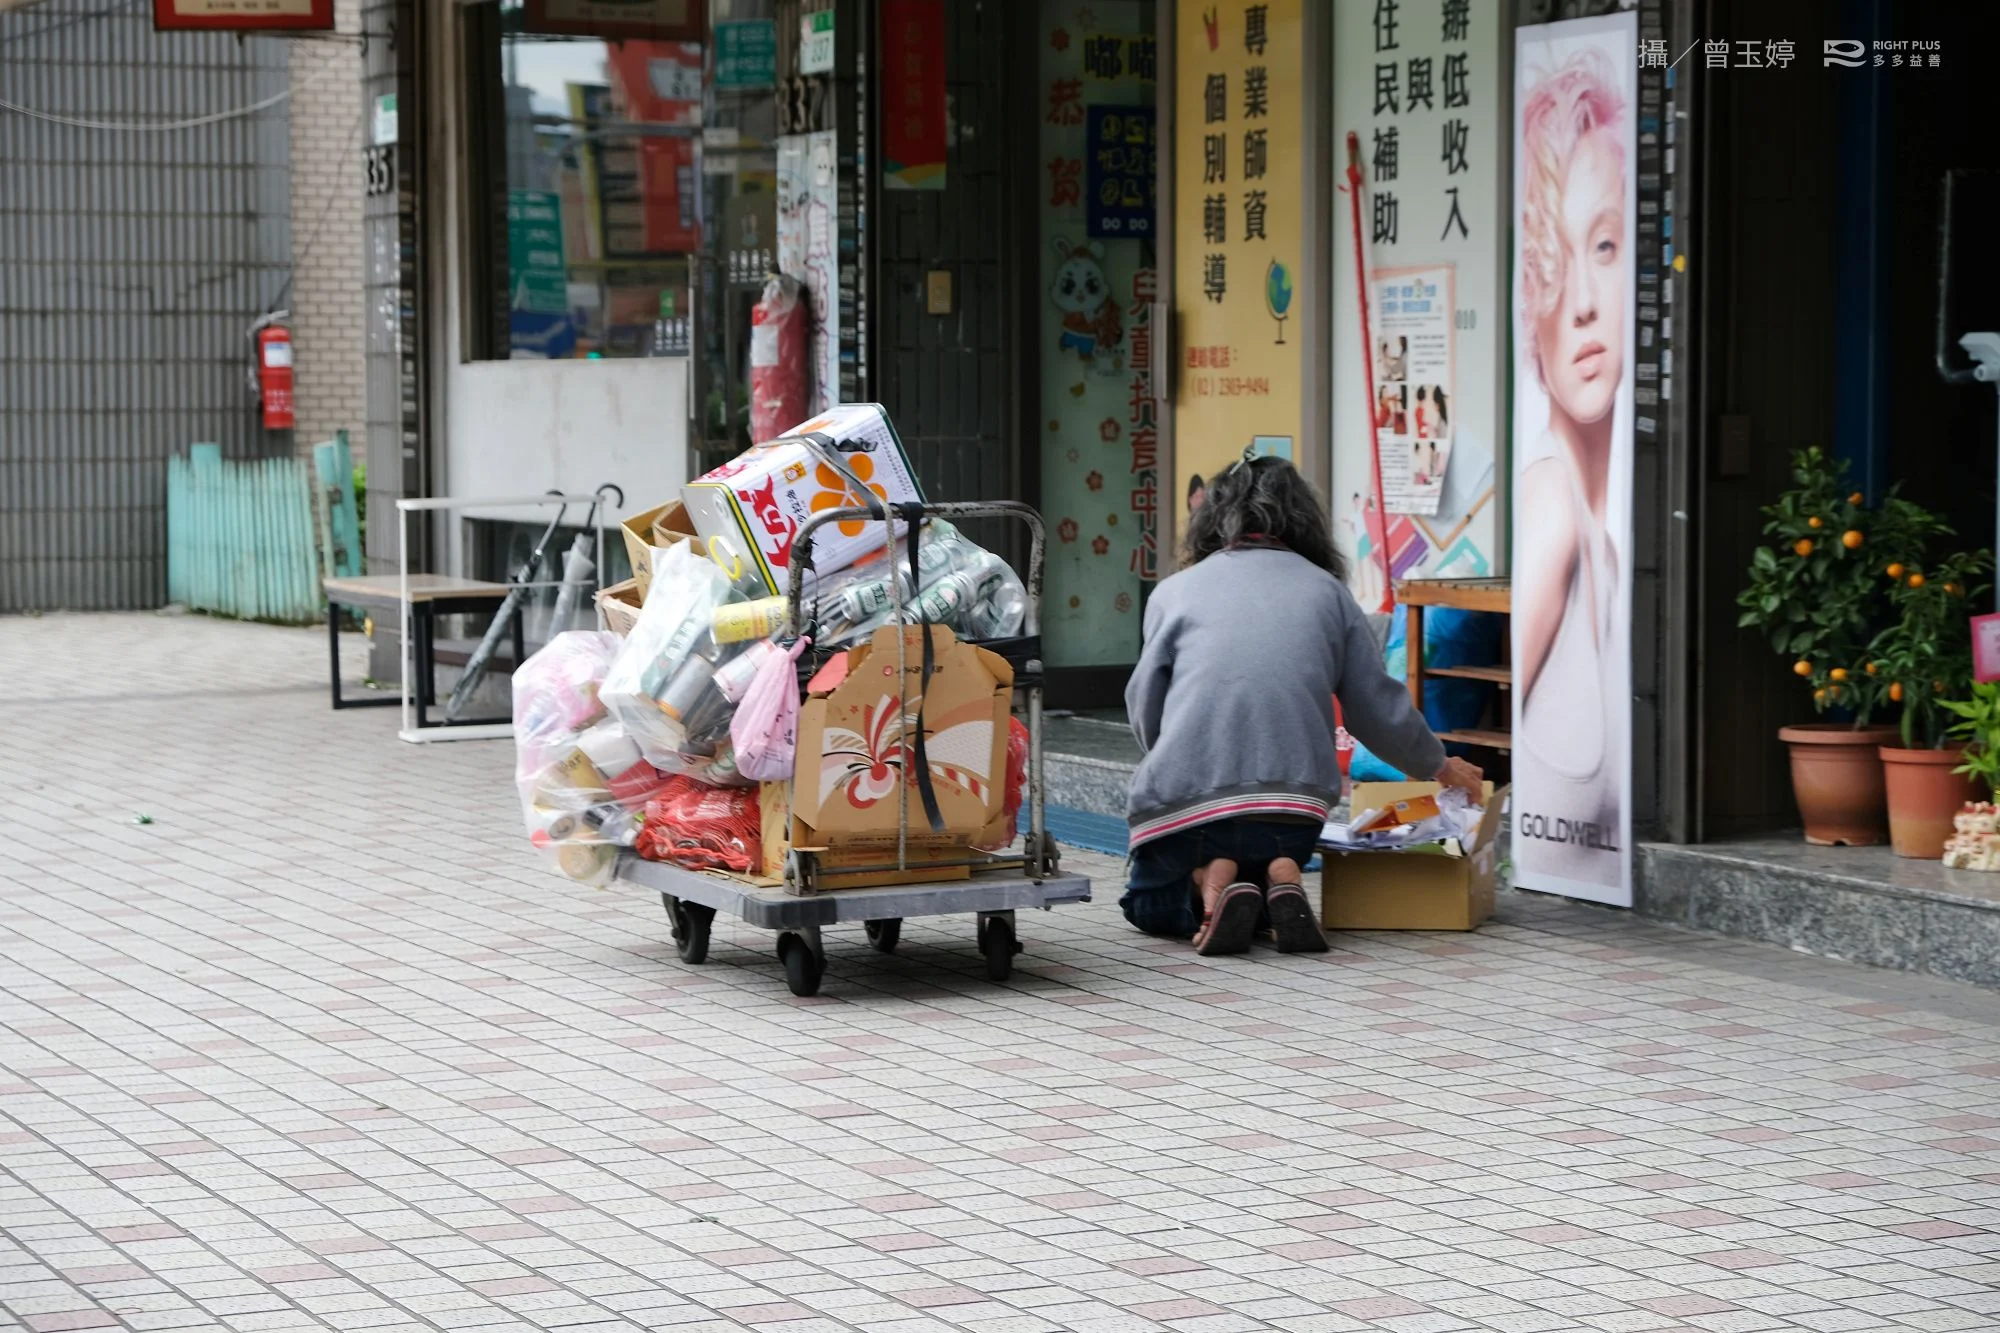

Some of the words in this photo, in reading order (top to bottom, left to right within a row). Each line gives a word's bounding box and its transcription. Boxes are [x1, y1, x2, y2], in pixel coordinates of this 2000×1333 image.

[1244, 4, 1268, 242] 專業師資
[1372, 0, 1399, 245] 住民補助
[1407, 57, 1433, 113] 與
[1102, 217, 1121, 230] DO
[1129, 218, 1148, 230] DO
[1203, 73, 1226, 304] 個別輔導
[1520, 812, 1620, 852] GOLDWELL
